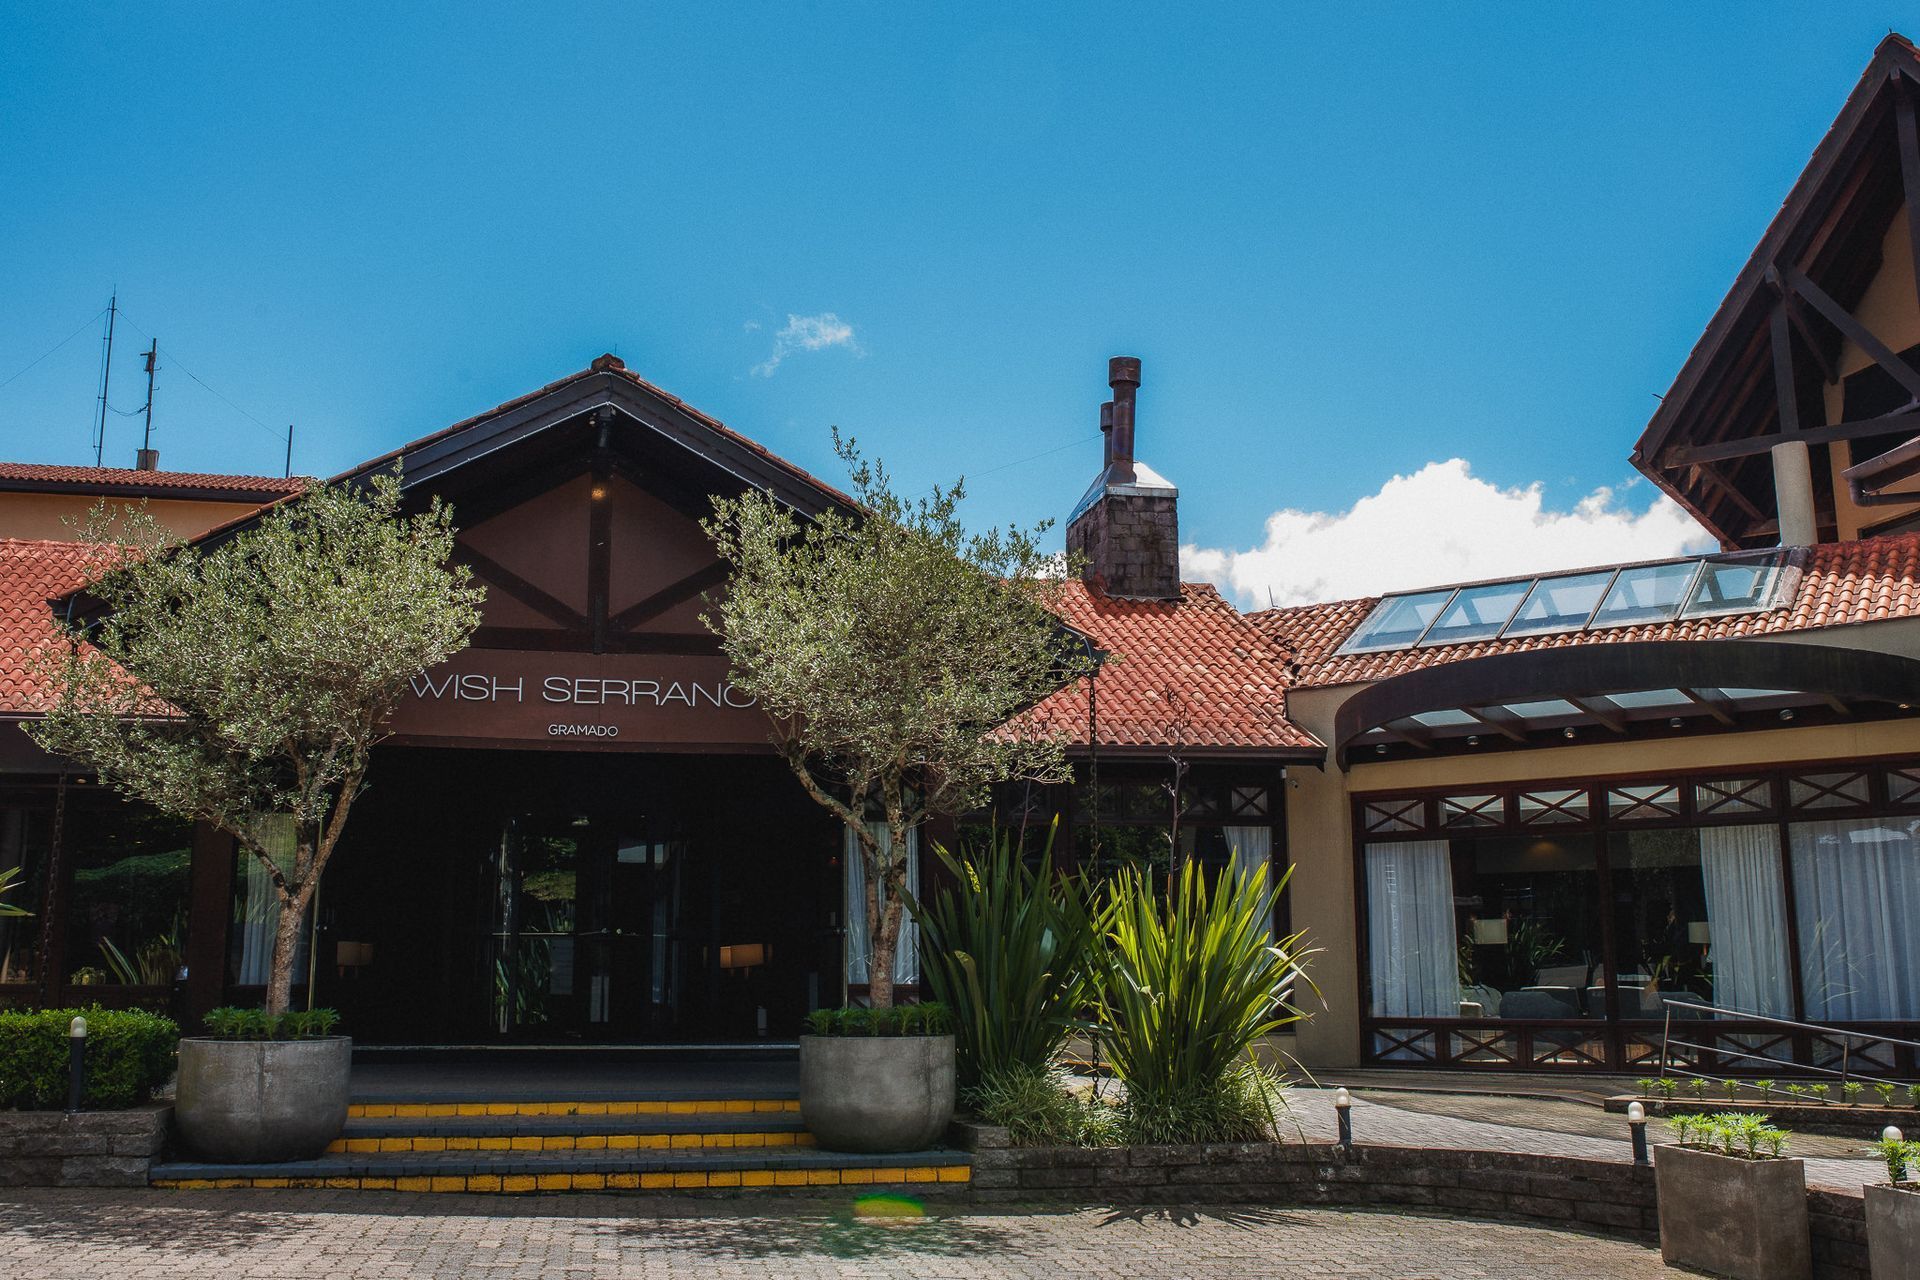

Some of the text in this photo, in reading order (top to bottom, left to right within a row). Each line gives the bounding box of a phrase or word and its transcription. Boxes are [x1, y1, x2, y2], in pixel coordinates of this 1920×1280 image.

[409, 673, 758, 708] WISH SERRANO
[548, 724, 619, 737] GRAMADO
